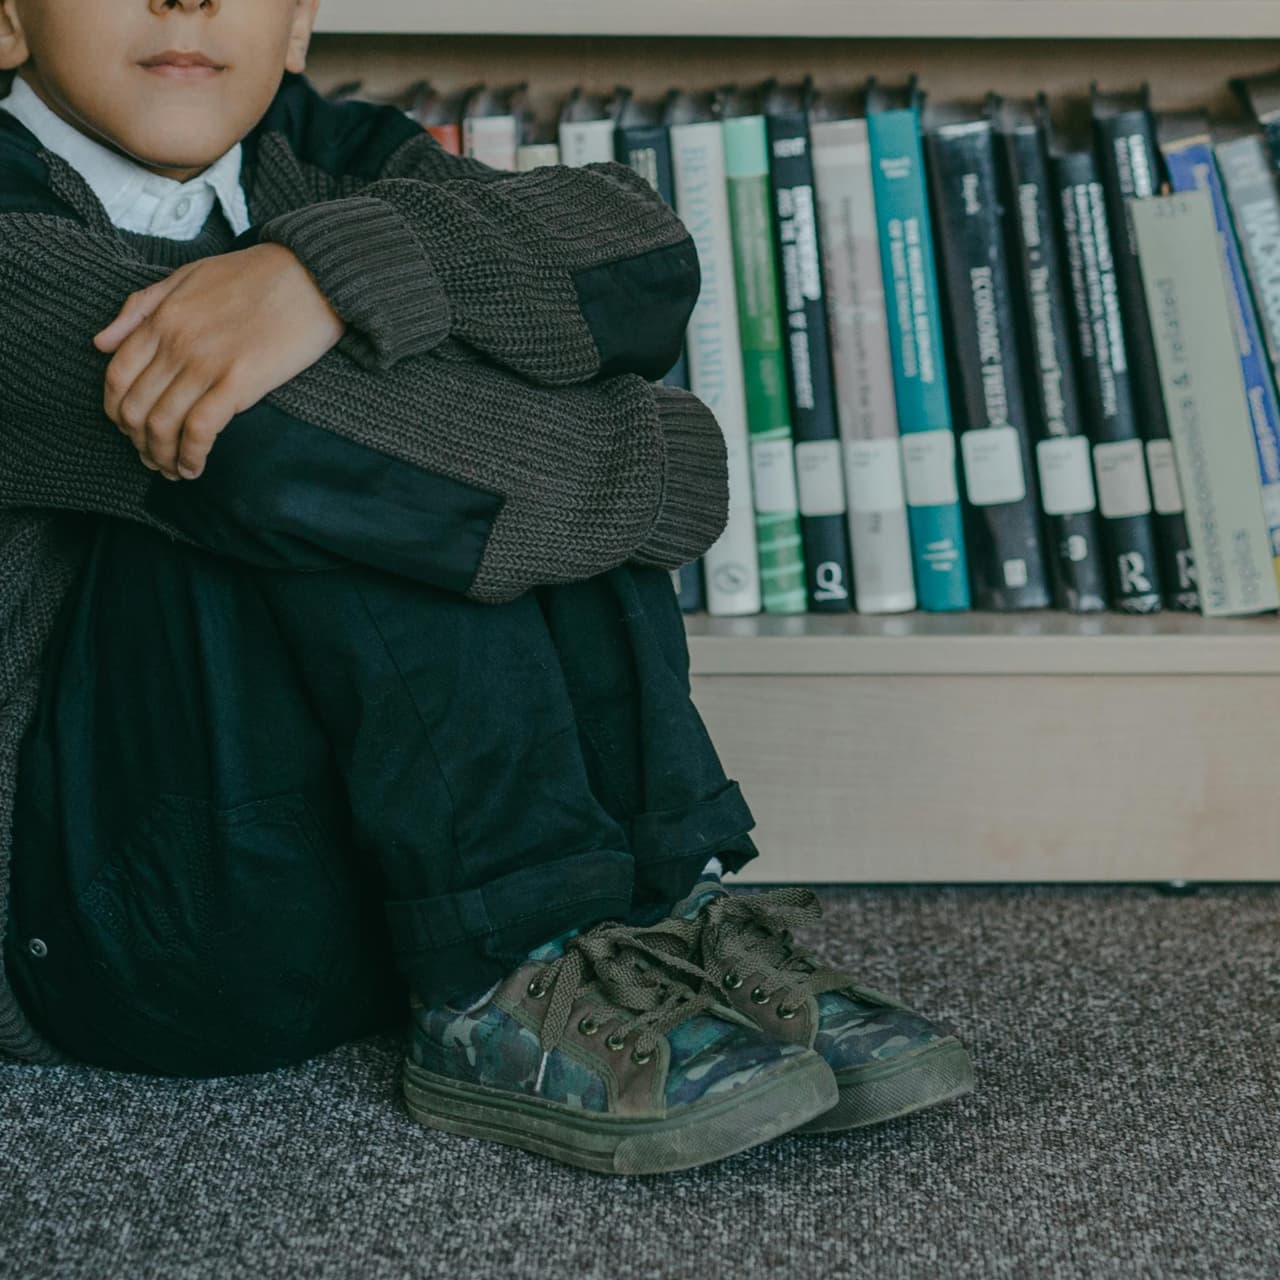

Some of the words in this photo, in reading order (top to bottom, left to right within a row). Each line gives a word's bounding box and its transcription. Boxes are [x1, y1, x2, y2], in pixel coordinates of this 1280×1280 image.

[683, 145, 714, 250] BEYOND
[968, 266, 1003, 365] ECONOMIC
[1028, 265, 1050, 292] The
[1150, 275, 1183, 366] related
[695, 321, 724, 410] LIMITS
[1030, 293, 1058, 371] International
[1170, 369, 1190, 390] &
[1179, 395, 1225, 609] Macroeconomics
[1231, 527, 1261, 609] topics
